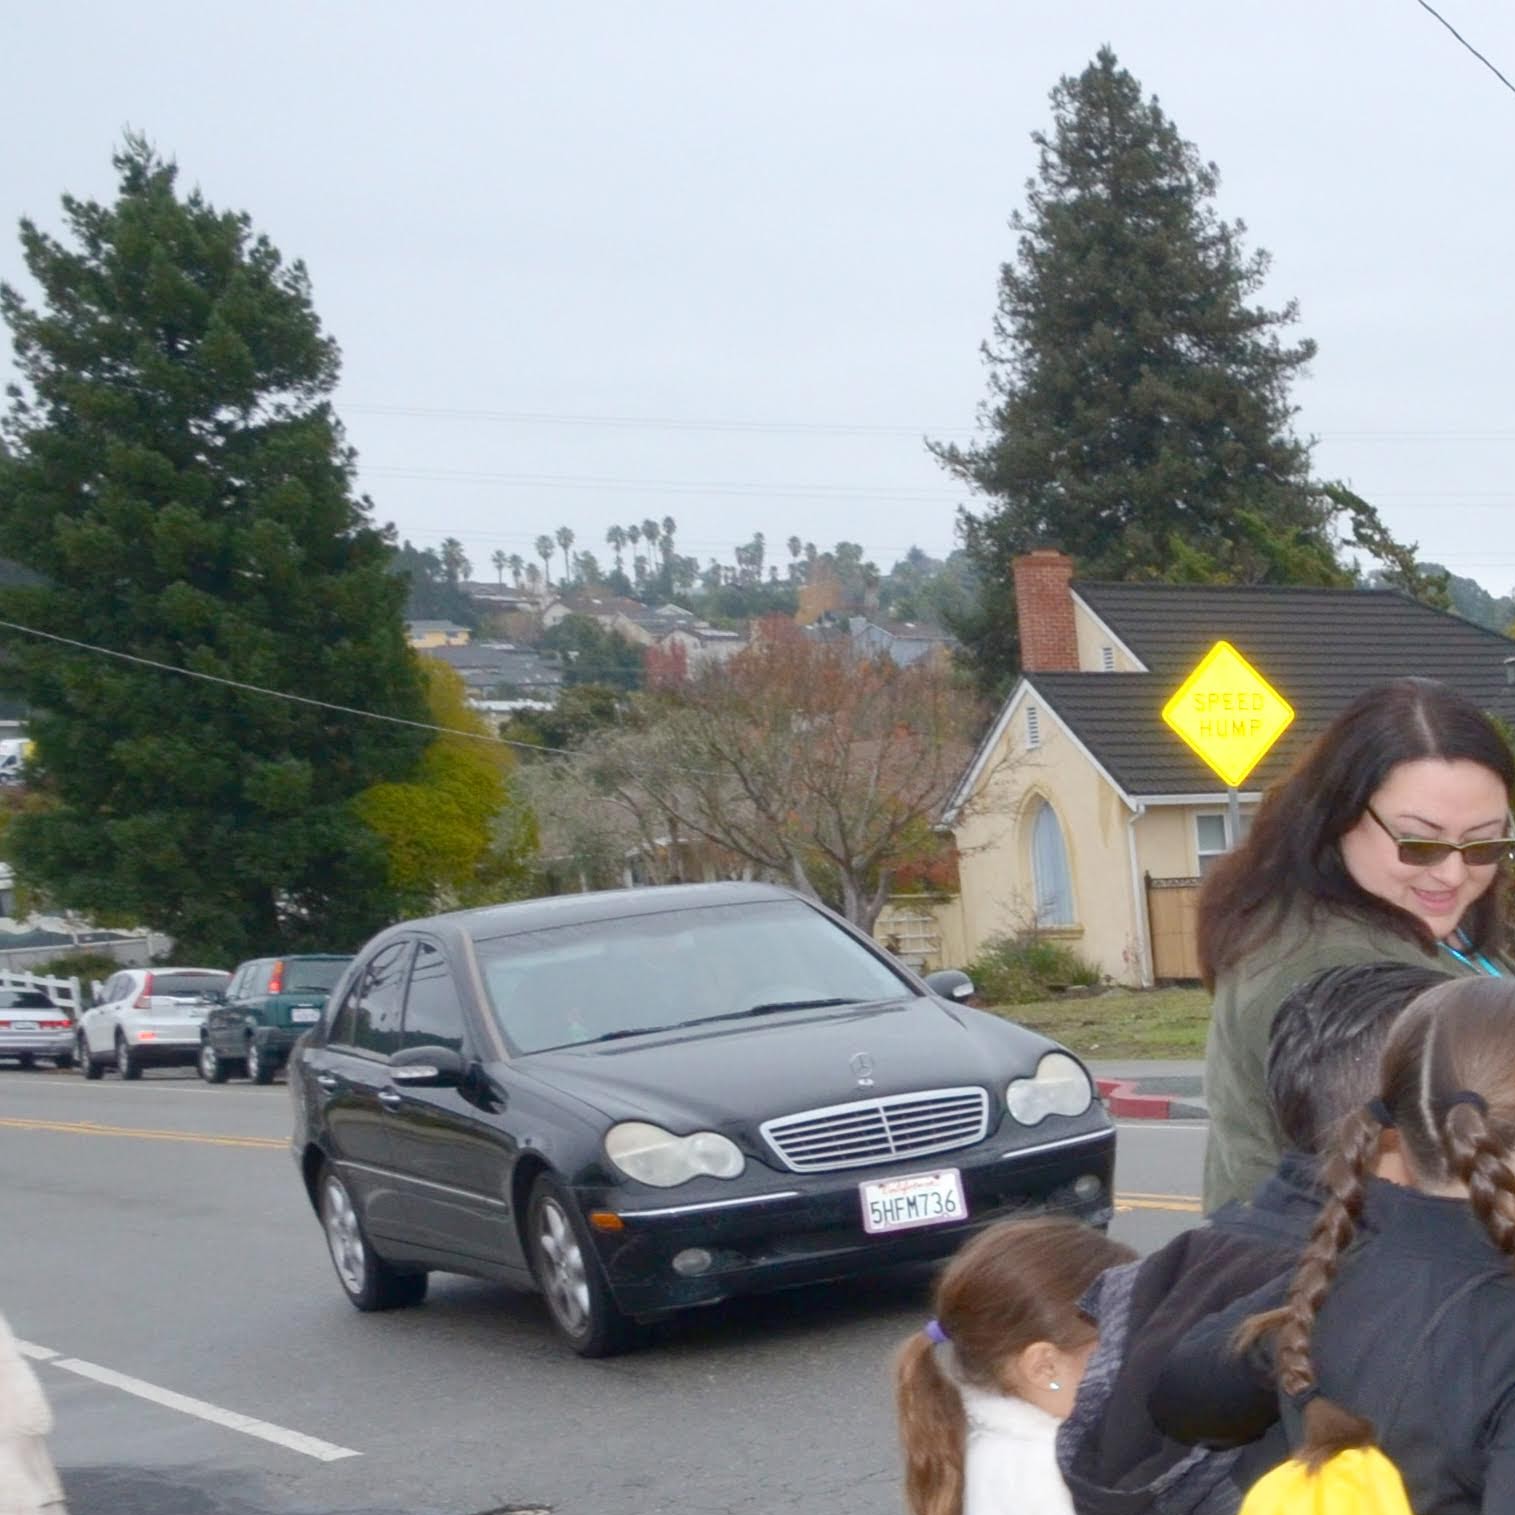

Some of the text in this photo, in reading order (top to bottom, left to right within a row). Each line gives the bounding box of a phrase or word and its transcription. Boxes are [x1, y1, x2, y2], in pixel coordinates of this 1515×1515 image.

[1193, 693, 1265, 711] SPEED
[1200, 719, 1263, 738] HUMP
[870, 1190, 956, 1223] 5HFM736
